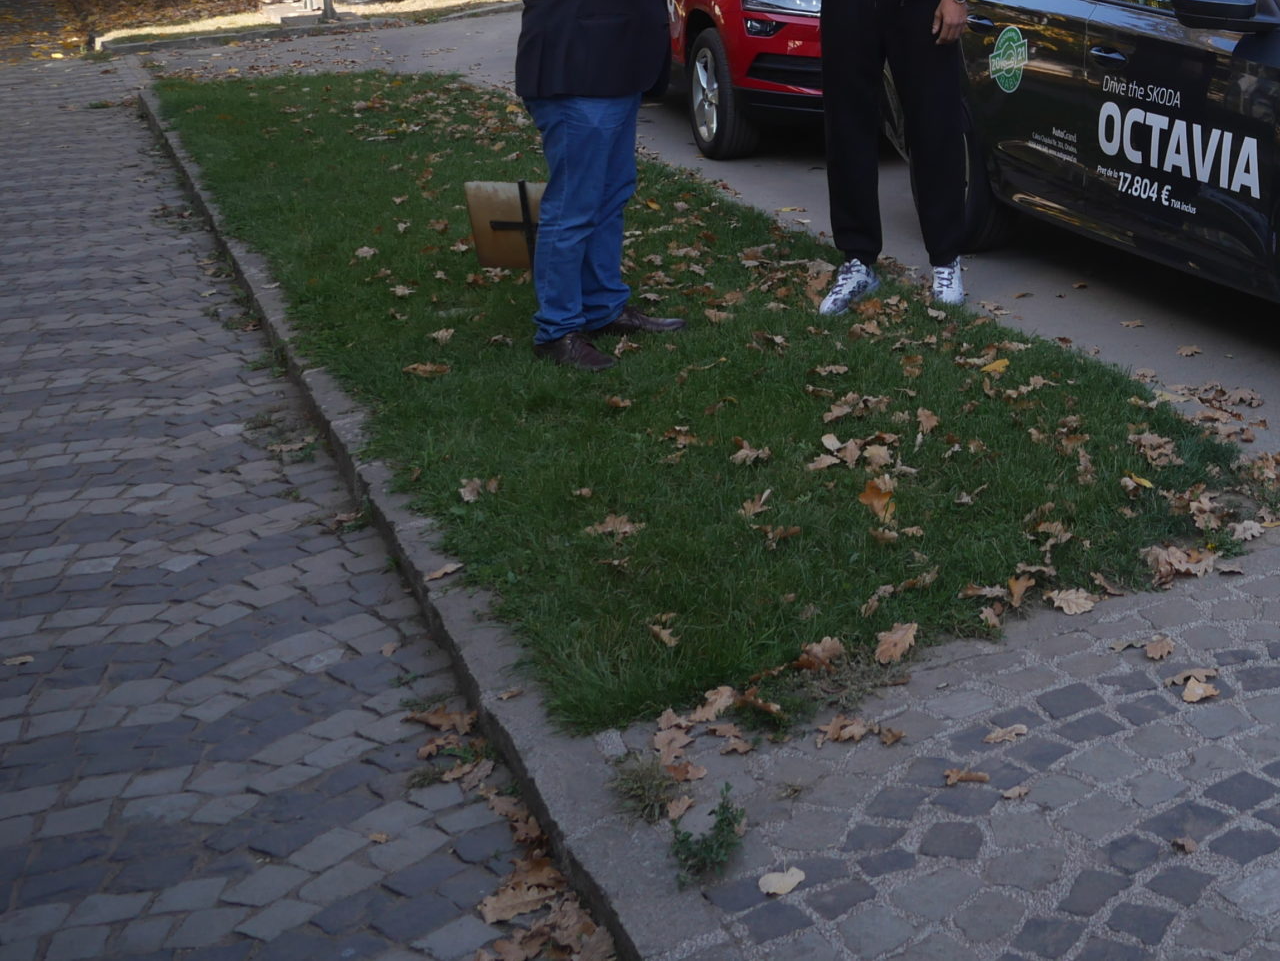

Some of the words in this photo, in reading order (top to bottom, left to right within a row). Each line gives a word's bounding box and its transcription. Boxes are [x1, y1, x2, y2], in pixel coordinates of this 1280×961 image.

[1102, 75, 1127, 96] Drive
[1128, 80, 1145, 100] the
[1145, 85, 1181, 109] SKODA
[1098, 101, 1260, 199] OCTAVIA
[1118, 171, 1158, 202] 17.804
[1161, 184, 1171, 206] €
